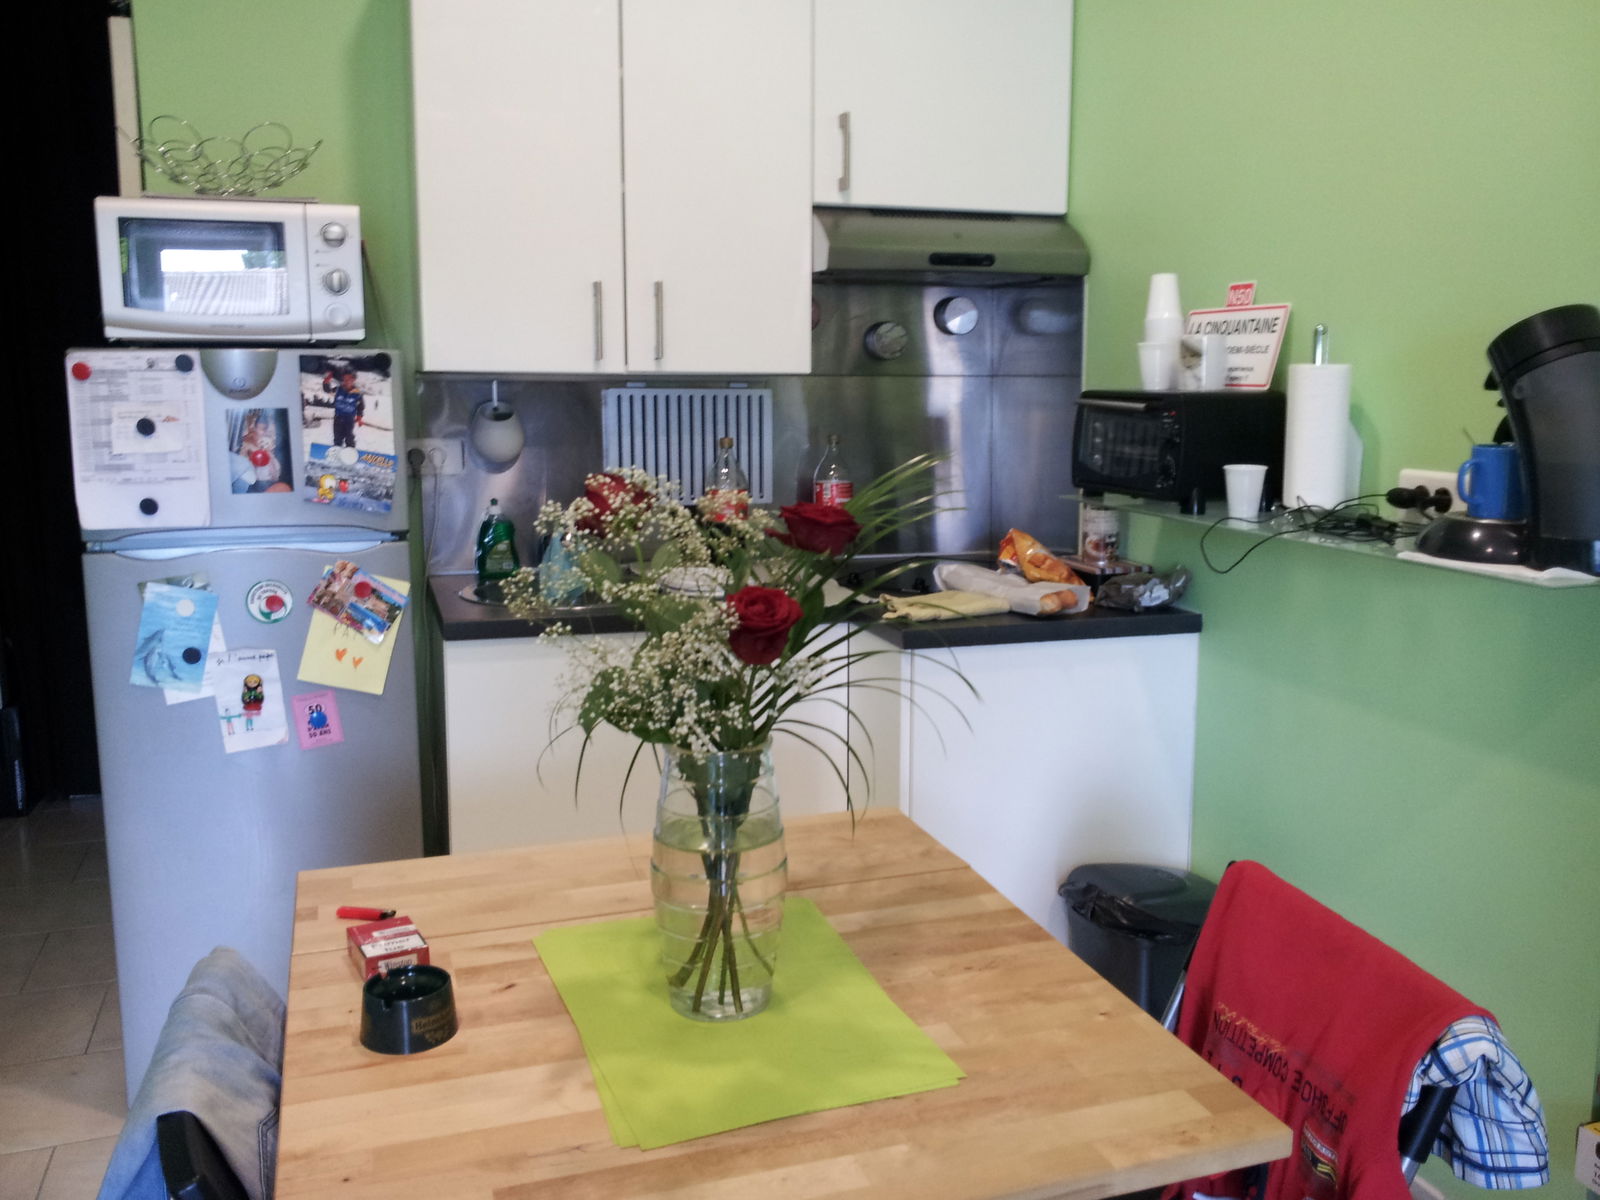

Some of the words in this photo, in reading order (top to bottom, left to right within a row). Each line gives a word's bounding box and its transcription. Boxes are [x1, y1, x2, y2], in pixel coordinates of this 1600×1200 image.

[1227, 288, 1252, 305] N50
[1189, 322, 1202, 335] LA
[1205, 317, 1280, 335] CINQUANTAINE
[308, 703, 322, 715] 50
[1213, 1010, 1289, 1082] COMPETITION
